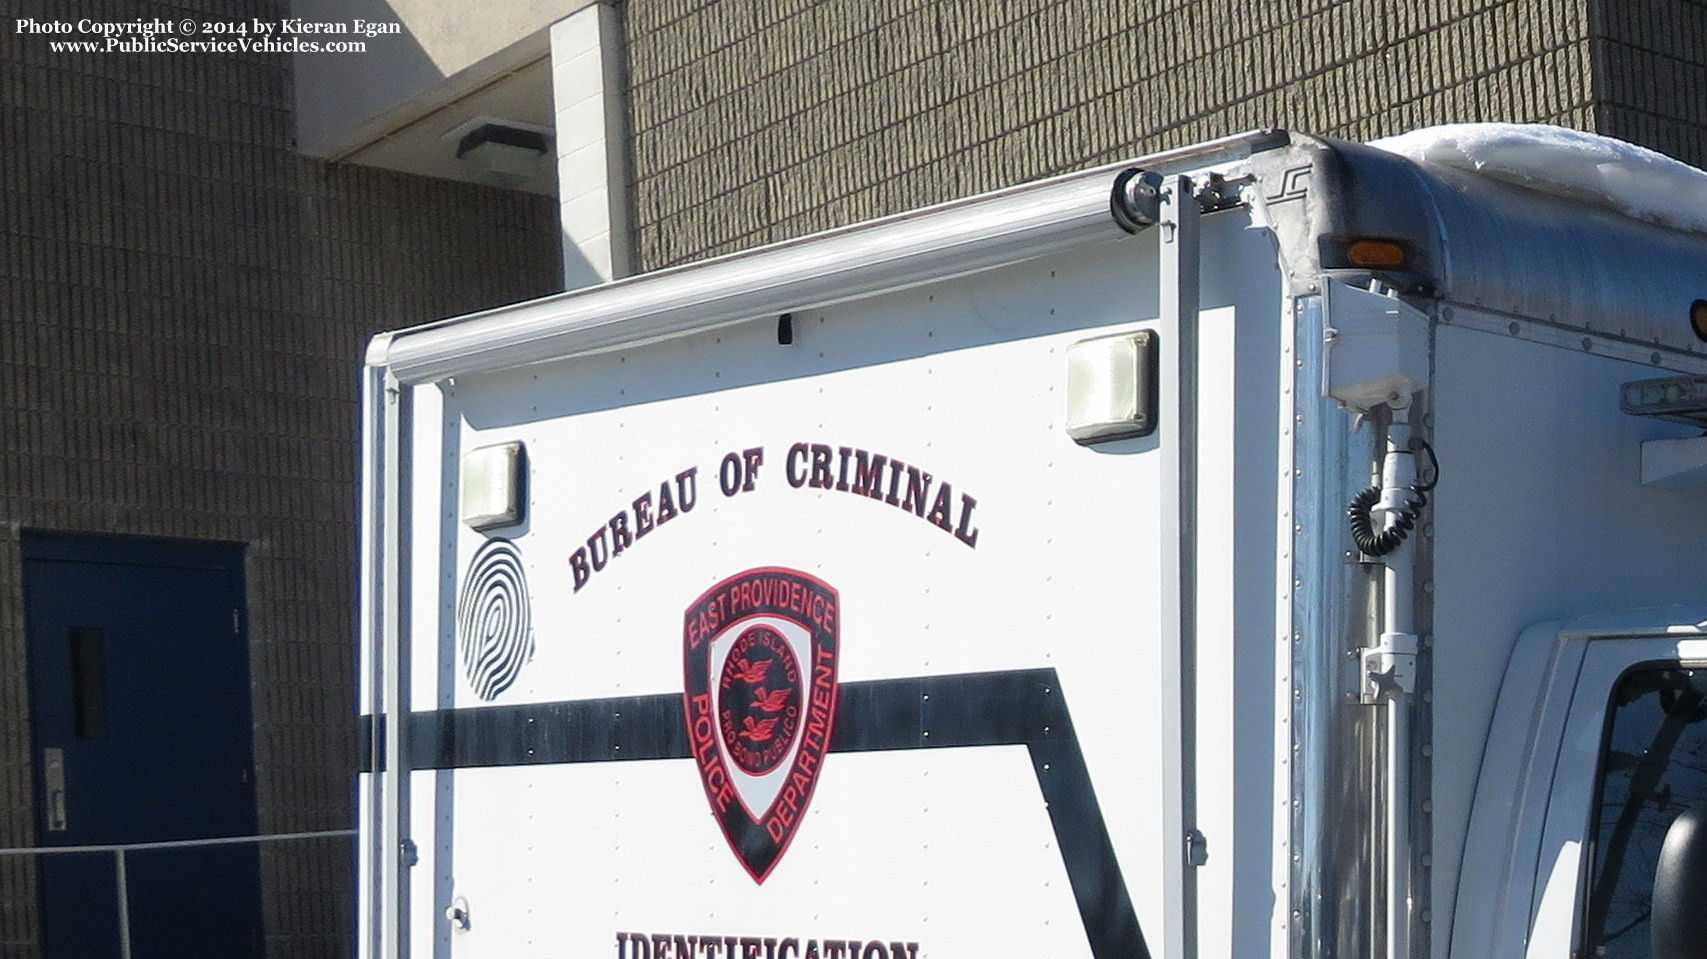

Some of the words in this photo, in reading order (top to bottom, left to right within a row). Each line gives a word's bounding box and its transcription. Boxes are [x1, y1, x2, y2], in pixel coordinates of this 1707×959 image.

[568, 465, 698, 594] BUREAU
[720, 446, 764, 497] OF
[786, 442, 980, 550] CRIMINAL
[688, 593, 727, 648] EAST
[731, 578, 836, 634] PROVIDENCE
[722, 632, 755, 689] RHODE
[759, 631, 797, 682] ISLAND
[692, 693, 735, 813] POLICE
[766, 643, 834, 844] DEPARTMENT
